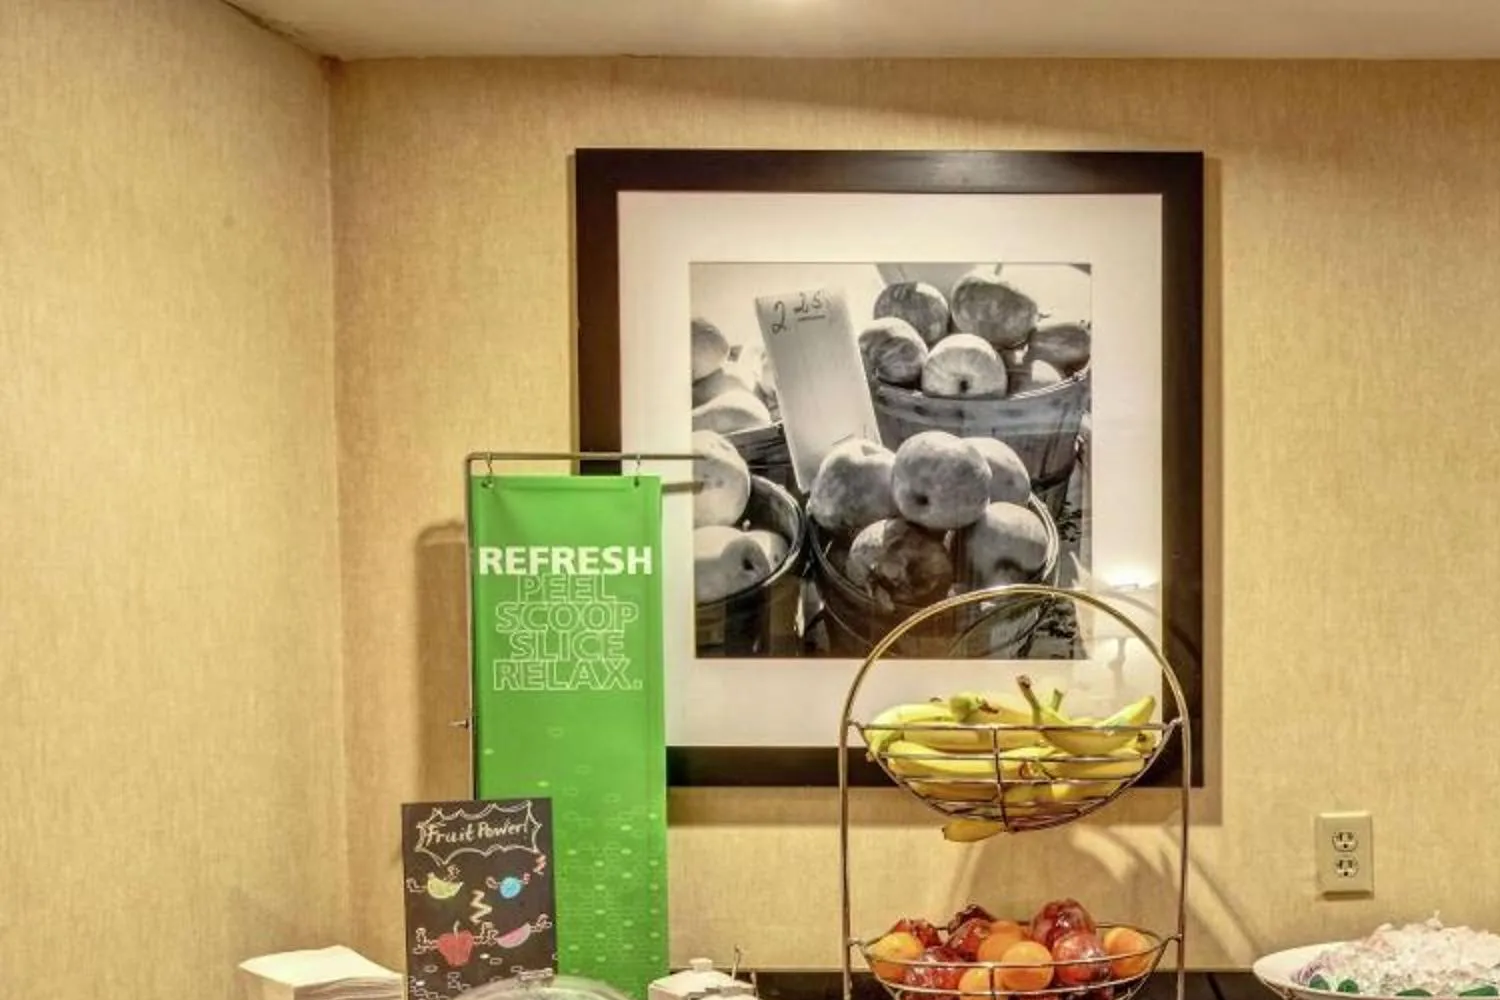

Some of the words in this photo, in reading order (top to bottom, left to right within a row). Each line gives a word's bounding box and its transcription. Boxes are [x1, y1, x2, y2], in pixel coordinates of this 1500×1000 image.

[479, 546, 653, 576] REFRESH
[518, 574, 617, 603] PEEL
[495, 601, 640, 633] SCOOP
[510, 630, 625, 662] SLICE
[493, 658, 643, 691] RELAX.
[425, 822, 474, 847] Fruit
[478, 818, 528, 840] Power!
